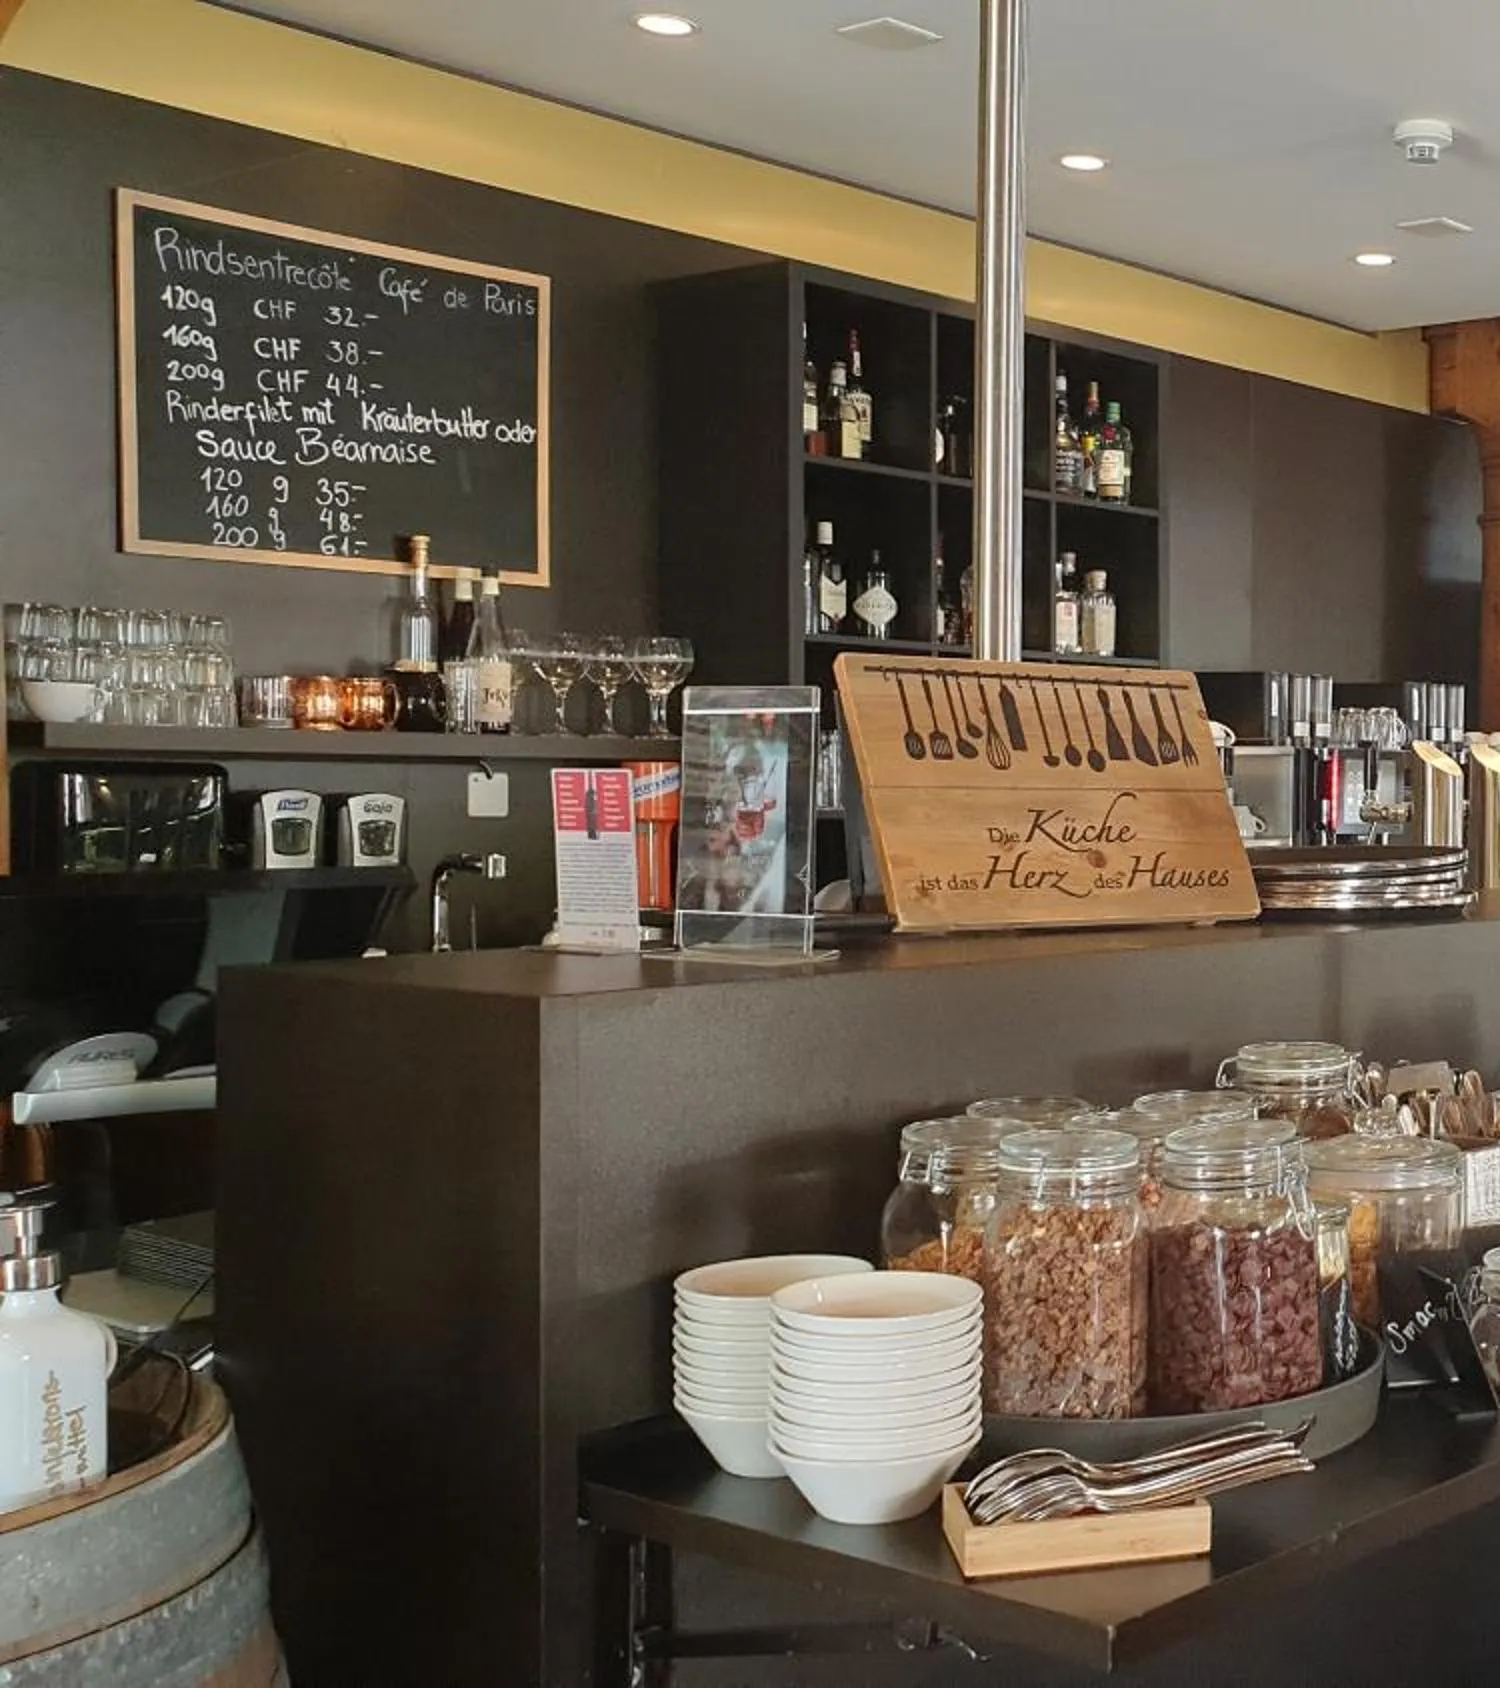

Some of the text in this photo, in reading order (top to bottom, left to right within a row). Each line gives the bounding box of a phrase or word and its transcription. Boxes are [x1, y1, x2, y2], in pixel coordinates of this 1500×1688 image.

[160, 284, 217, 327] 120g
[253, 299, 297, 320] CHF
[378, 267, 428, 315] Café
[443, 286, 469, 308] de
[484, 283, 536, 315] Paris
[161, 324, 218, 362] 160g
[253, 337, 301, 361] CHF
[166, 359, 225, 392] 200g
[257, 369, 309, 394] CHF
[166, 389, 293, 437] Rinderfilet
[301, 397, 336, 425] mit
[494, 419, 537, 444] oder
[195, 429, 287, 465] Sauce
[200, 466, 244, 493] 120
[272, 475, 290, 503] g
[205, 493, 250, 520] 160
[211, 521, 259, 548] 200
[988, 791, 1137, 853] Die Küche
[920, 851, 1230, 898] ist das Herz des Hauses
